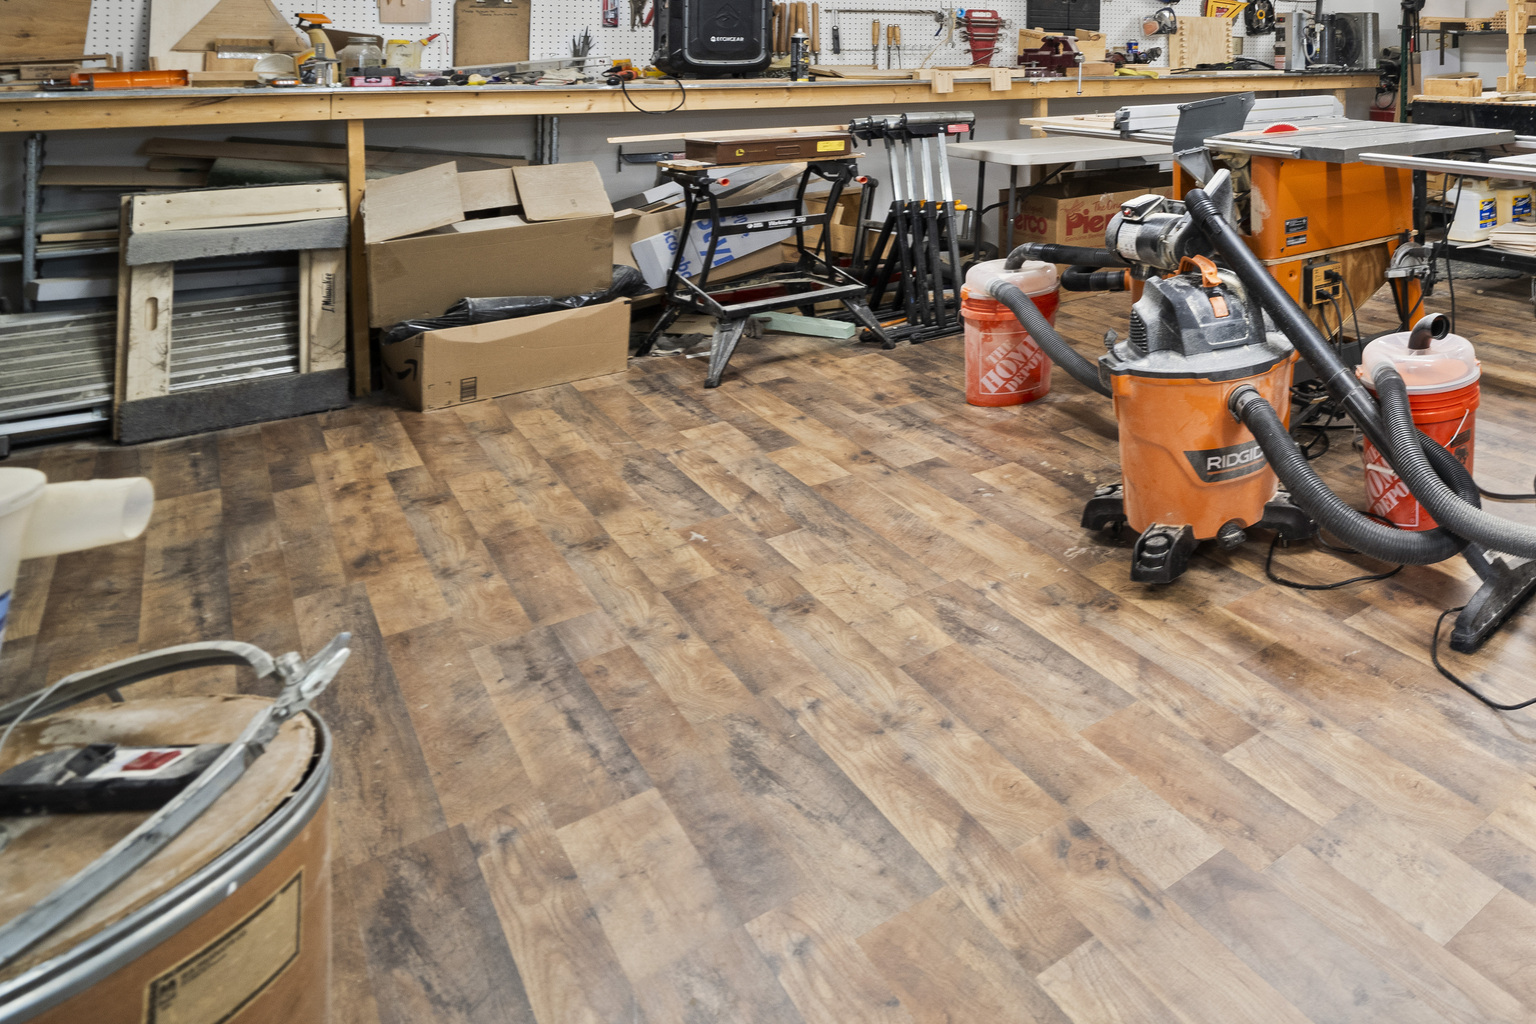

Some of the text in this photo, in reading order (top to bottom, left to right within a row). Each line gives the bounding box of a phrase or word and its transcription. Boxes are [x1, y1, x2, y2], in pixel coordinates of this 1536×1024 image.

[985, 339, 1016, 365] THE
[1207, 445, 1264, 471] RIDGID
[1374, 481, 1410, 517] DEPO
